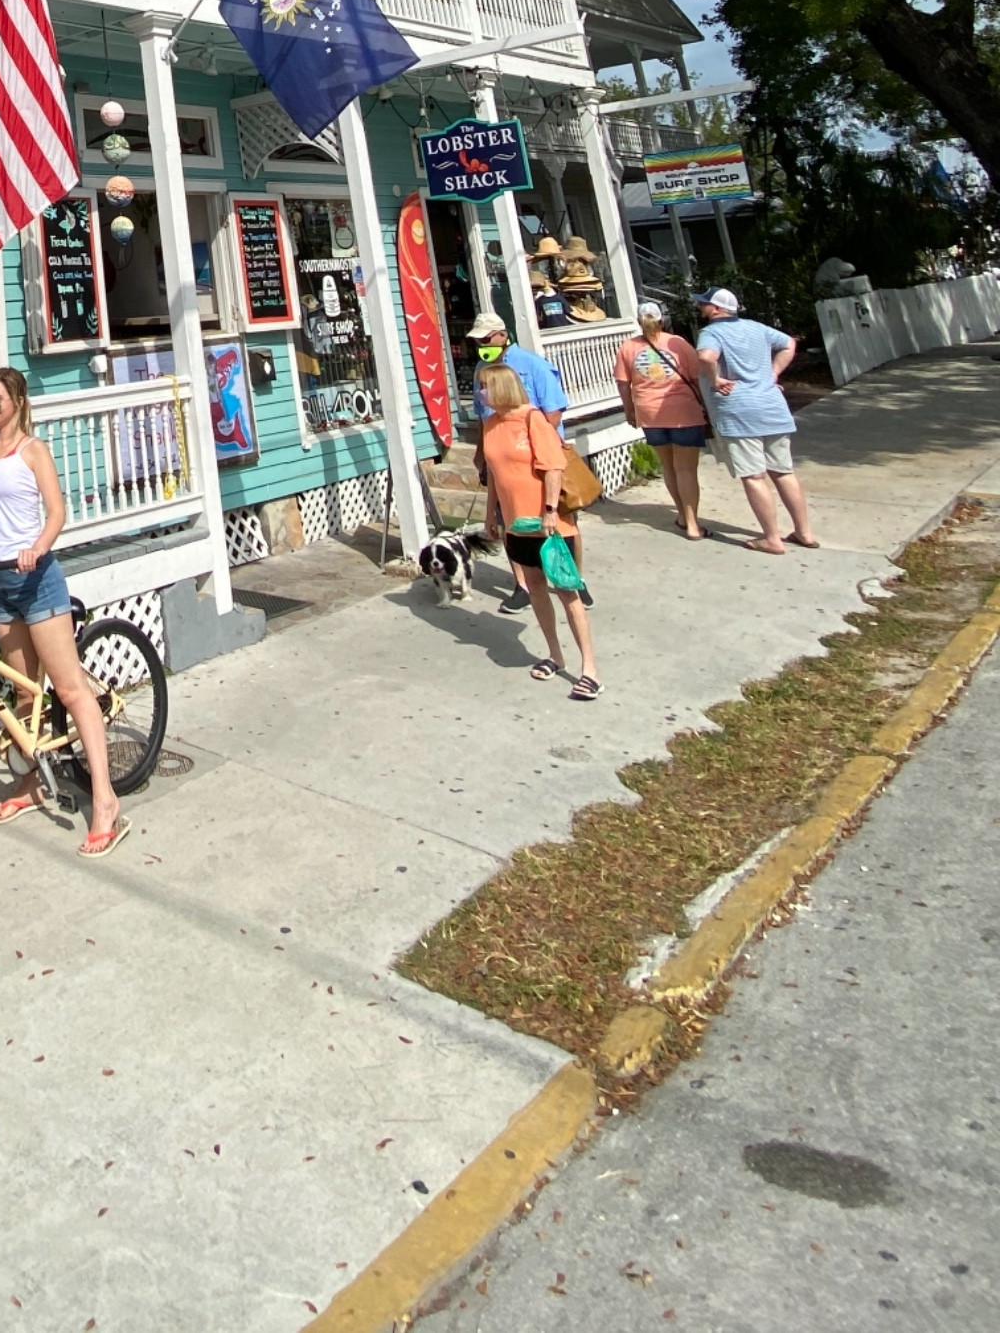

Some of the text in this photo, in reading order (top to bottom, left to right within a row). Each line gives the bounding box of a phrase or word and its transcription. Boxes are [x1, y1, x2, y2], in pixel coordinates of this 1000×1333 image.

[460, 125, 475, 134] The
[426, 128, 517, 155] LOBSTER
[444, 170, 510, 191] SHACK
[654, 174, 740, 191] SURF SHOP
